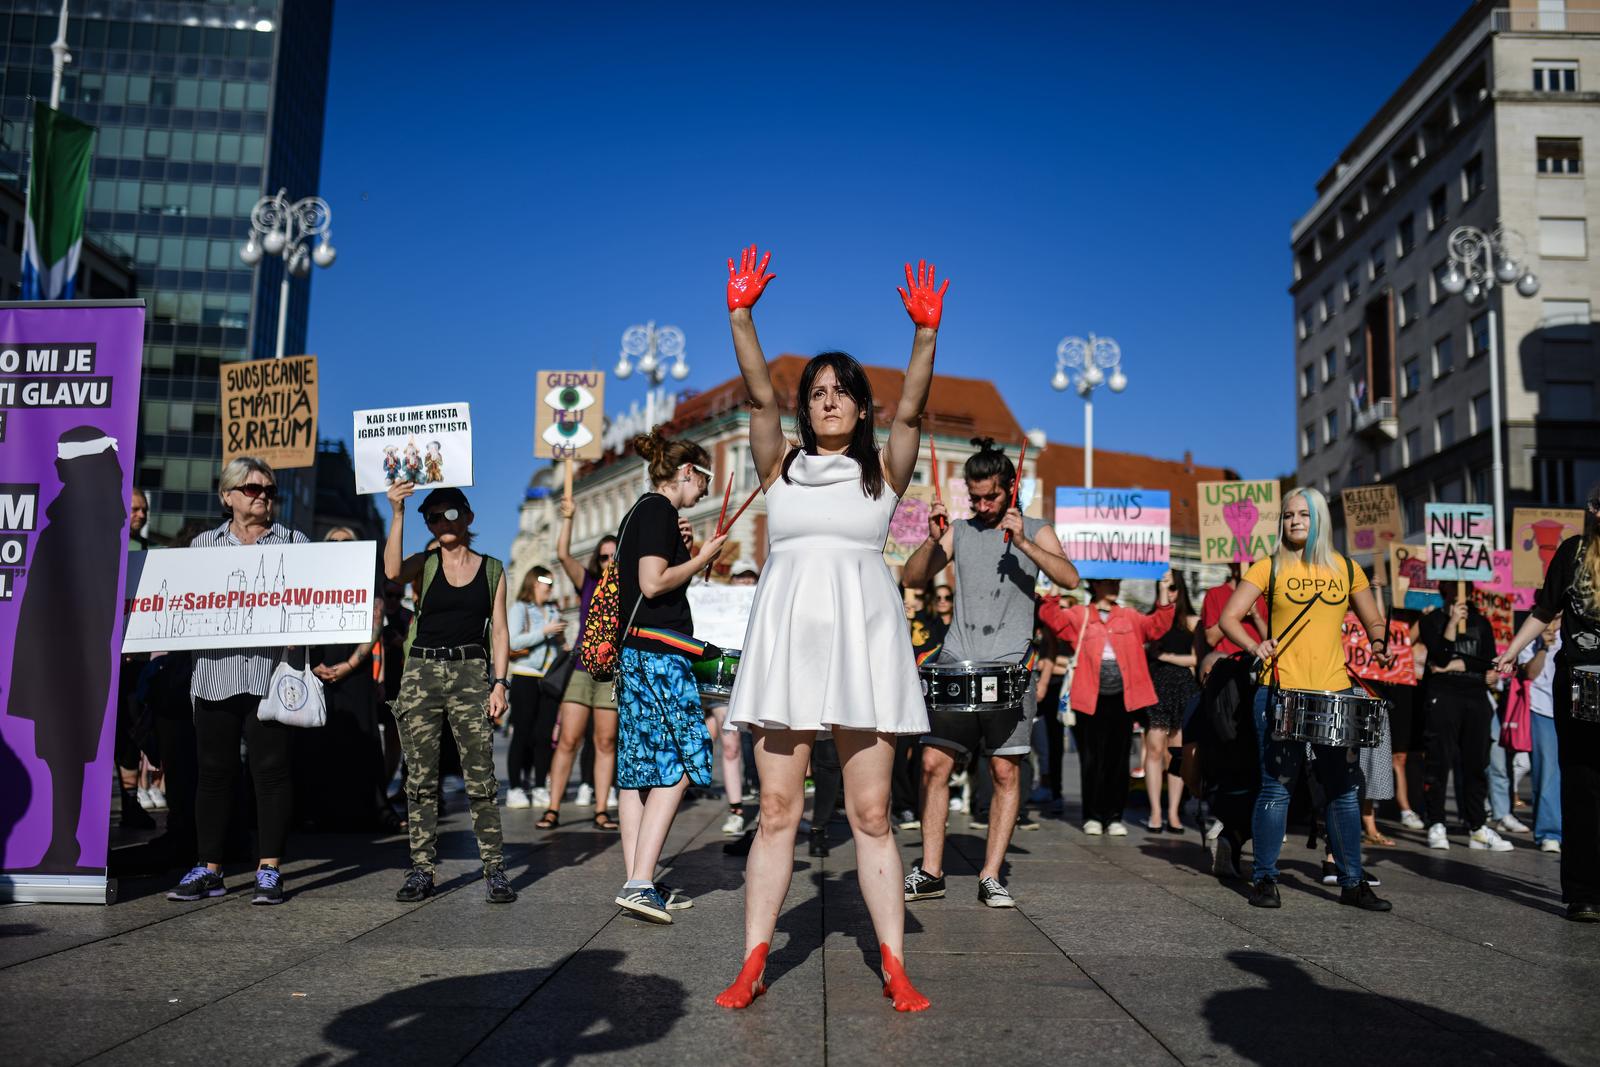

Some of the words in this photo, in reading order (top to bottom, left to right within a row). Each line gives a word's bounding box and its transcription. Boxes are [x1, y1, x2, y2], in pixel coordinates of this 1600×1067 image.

[26, 349, 59, 372] MI
[63, 349, 92, 372] JE
[227, 358, 314, 396] SUOSJEĆANJE
[546, 373, 598, 388] GLEDAJ
[22, 382, 108, 406] GLAVU
[228, 389, 312, 422] EMPATIJA
[366, 414, 385, 425] KAD
[387, 412, 397, 423] SE
[399, 412, 406, 421] U
[407, 411, 424, 421] IME
[425, 408, 458, 420] KRISTA
[358, 425, 385, 439] IGRAŠ
[1078, 491, 1143, 521] TRANS
[1205, 483, 1273, 506] USTANI
[1431, 511, 1484, 540] NIJE
[1431, 543, 1493, 571] FAZA
[1287, 577, 1345, 591] OPPAI
[168, 587, 368, 611] #SafePlace4Women
